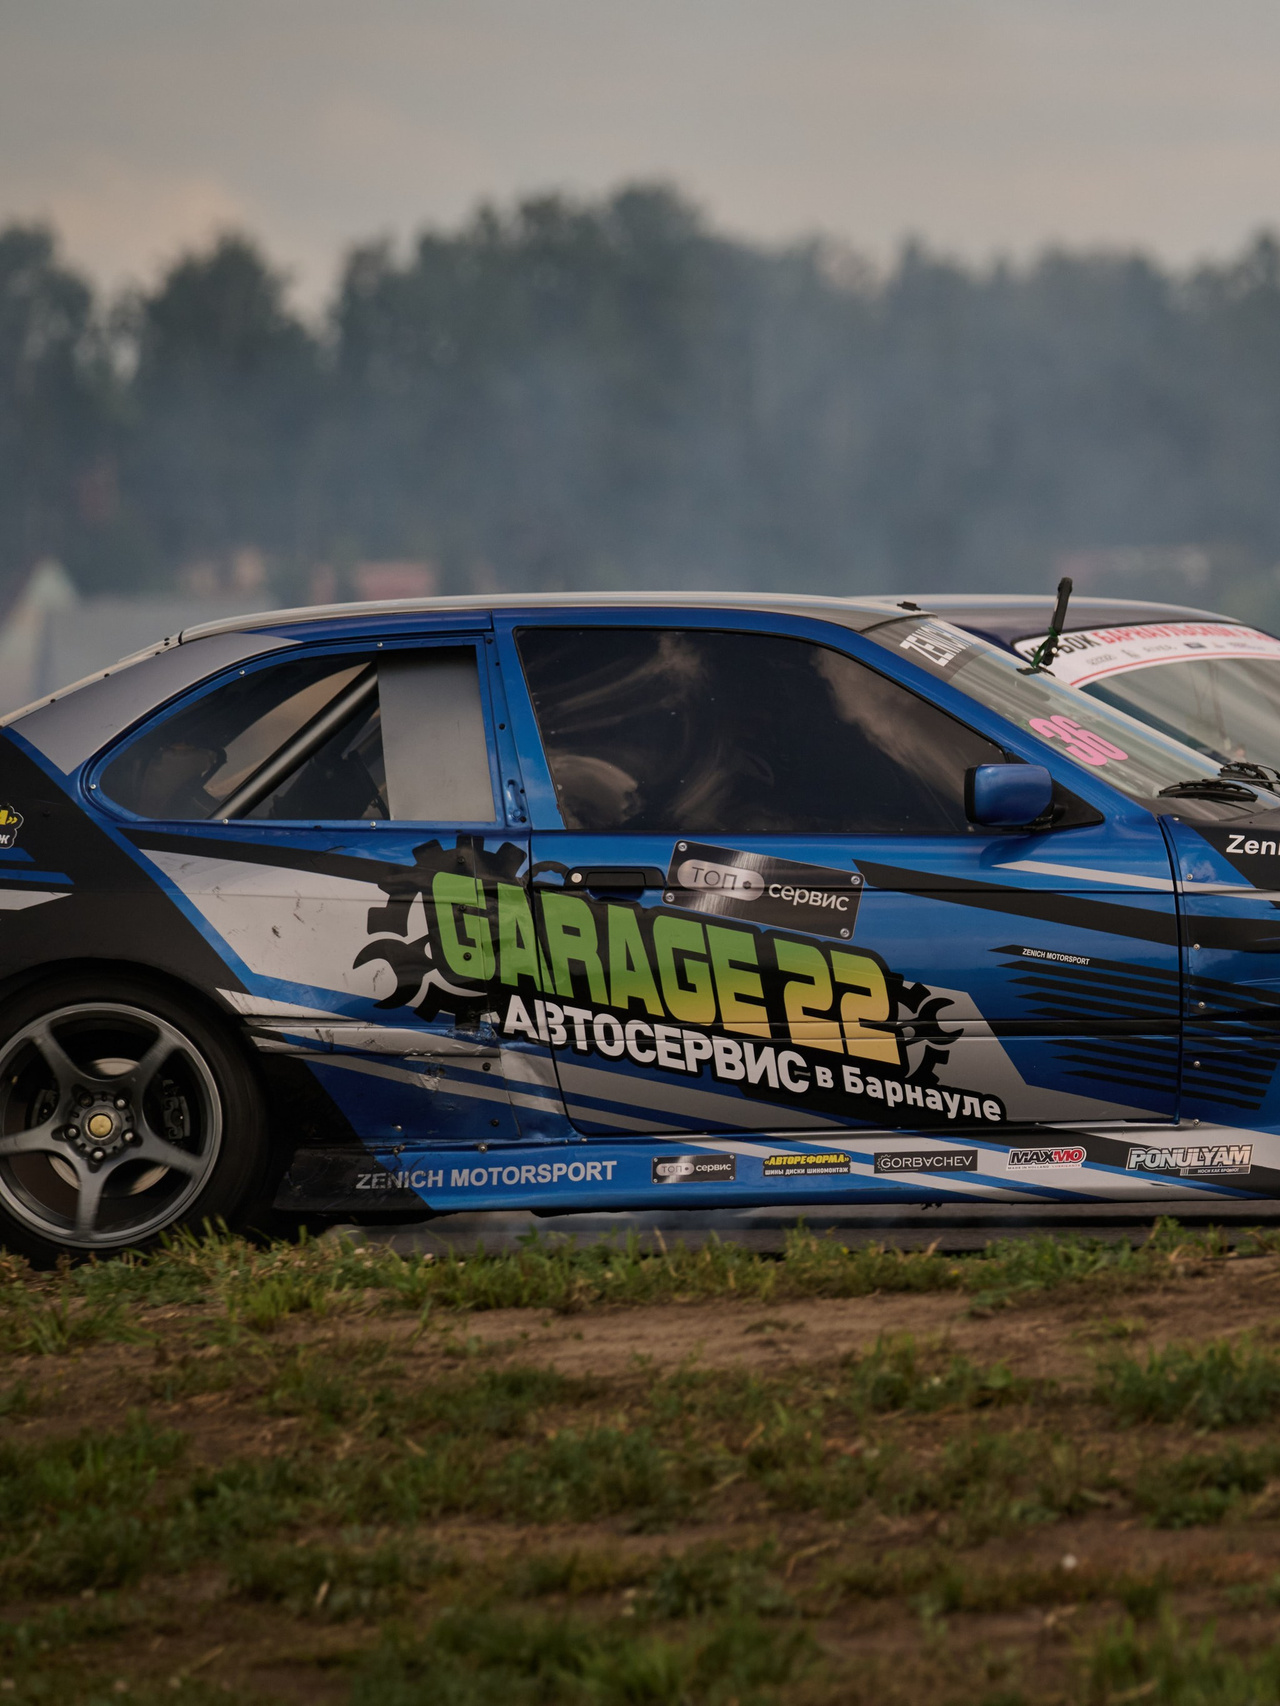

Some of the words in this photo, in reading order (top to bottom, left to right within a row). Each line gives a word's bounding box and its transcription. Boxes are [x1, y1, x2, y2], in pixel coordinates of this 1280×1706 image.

[900, 623, 973, 667] ZENICH
[1029, 715, 1128, 766] 36
[691, 866, 737, 890] ТОП
[768, 883, 850, 911] сервис
[432, 871, 772, 1039] GARAGE
[773, 938, 901, 1065] 22
[1022, 948, 1046, 959] ZENICH
[1046, 952, 1090, 965] MOTORSPORT
[504, 994, 811, 1093] АВТОСЕРВИС
[815, 1065, 834, 1088] в
[842, 1064, 1002, 1121] Барнауле
[356, 1169, 444, 1190] ZENICH
[450, 1161, 617, 1187] MOTORSPORT
[662, 1164, 682, 1173] ТОП
[696, 1164, 731, 1172] сервис
[1128, 1145, 1250, 1169] PONULYAM
